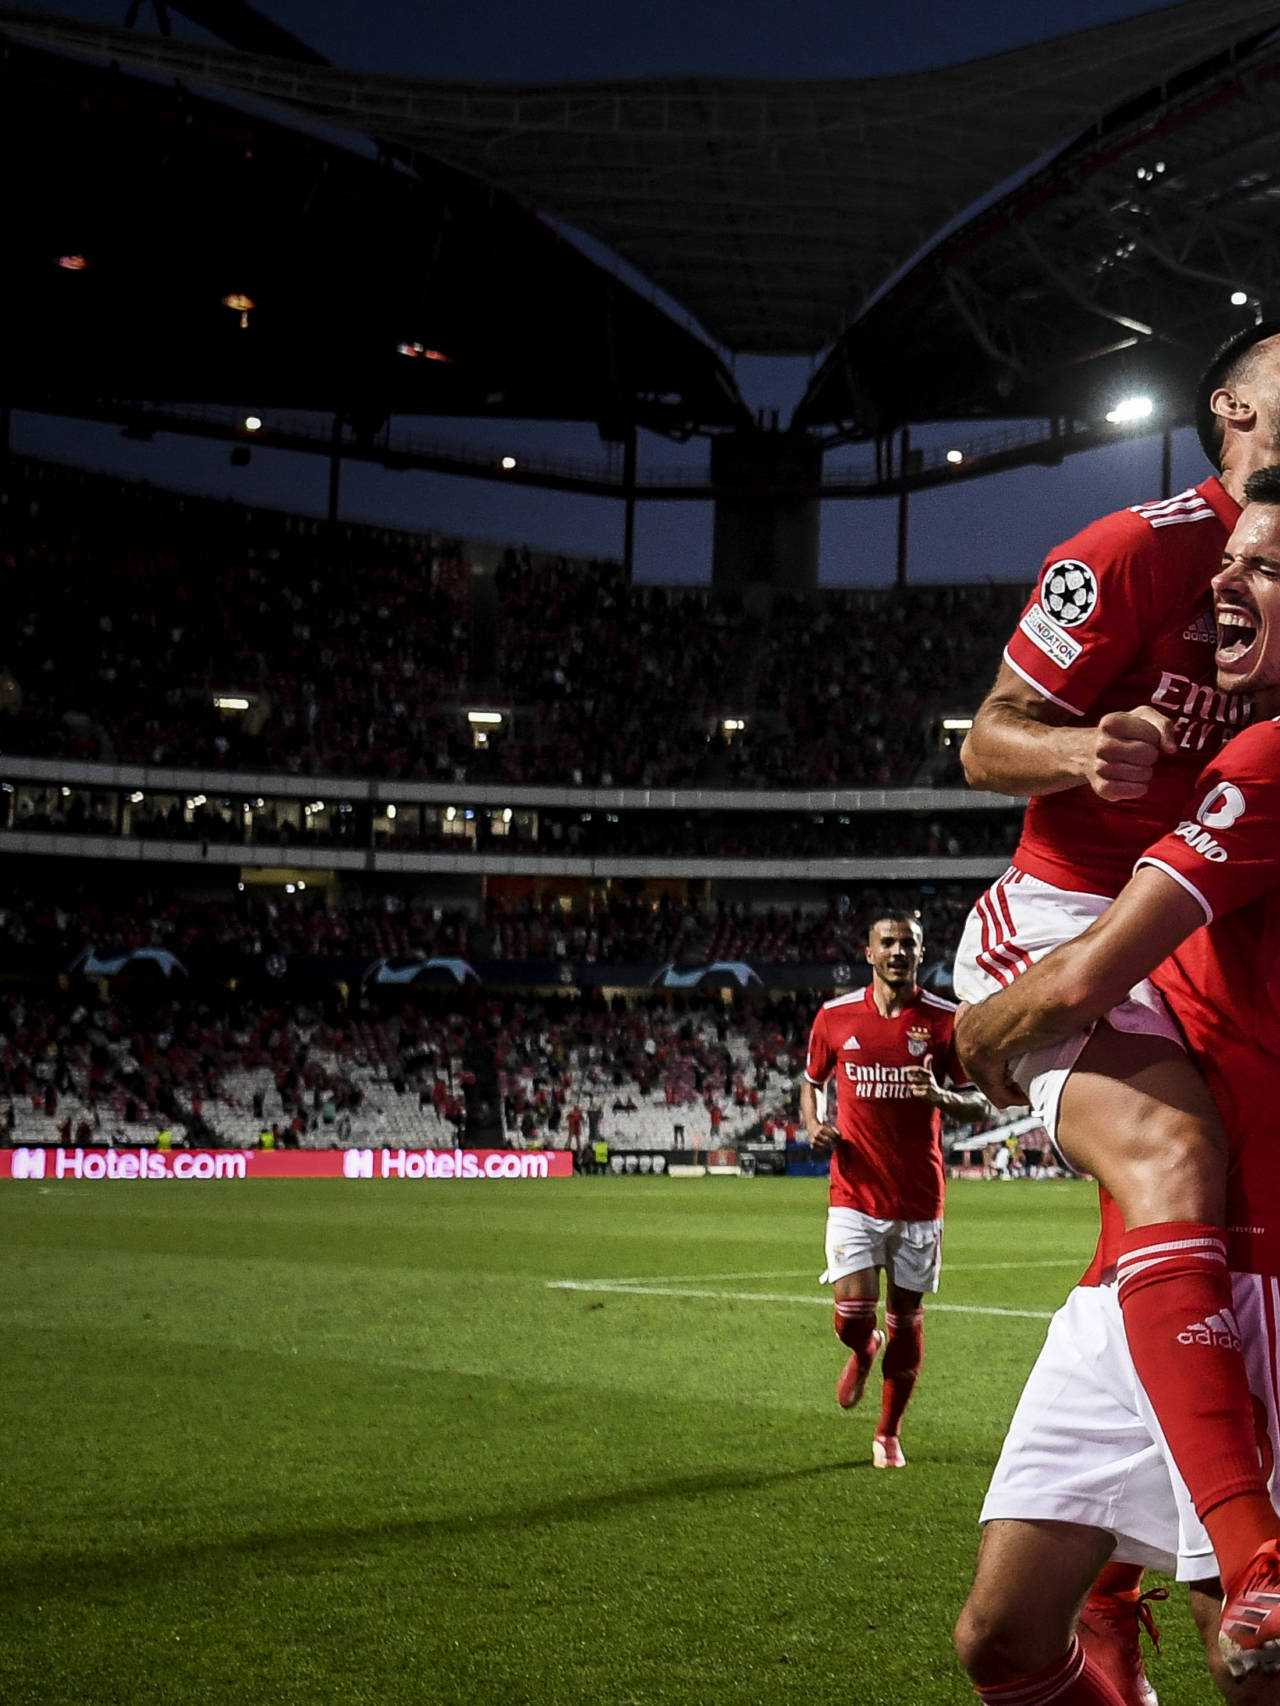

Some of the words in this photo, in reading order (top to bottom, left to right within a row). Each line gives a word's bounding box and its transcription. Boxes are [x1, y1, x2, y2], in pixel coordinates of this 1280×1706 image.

[856, 1082, 873, 1098] FLY
[56, 1147, 247, 1180] Hotels.com
[381, 1148, 549, 1179] Hotels.com
